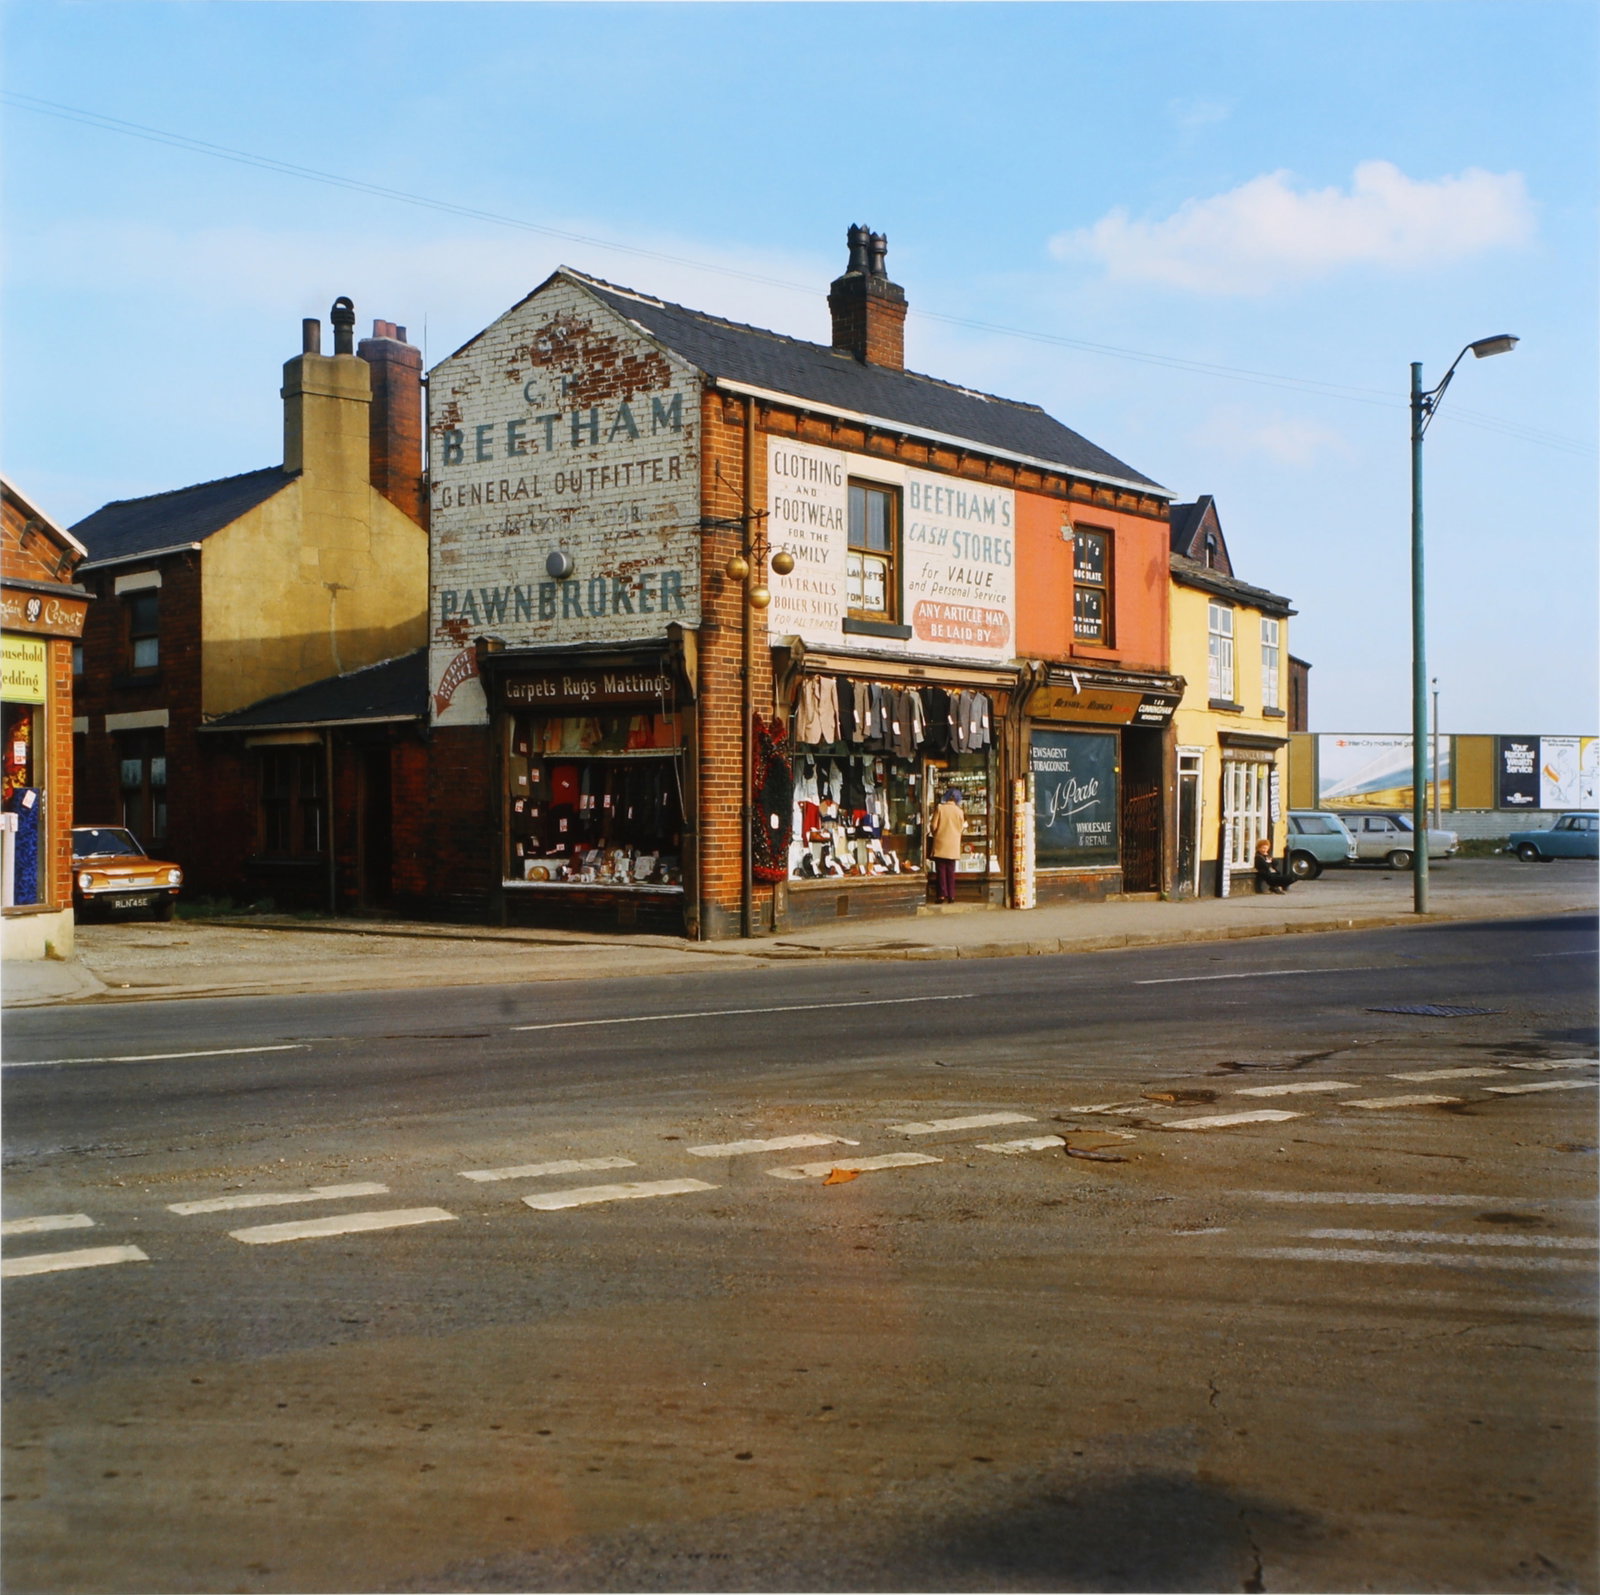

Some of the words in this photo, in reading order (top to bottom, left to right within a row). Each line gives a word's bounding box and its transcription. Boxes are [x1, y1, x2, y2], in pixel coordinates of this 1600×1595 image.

[442, 392, 682, 467] BEETHAM
[774, 451, 842, 487] CLOTHING
[442, 473, 543, 508] GENERAL
[554, 455, 681, 496] OUTFITTER
[796, 485, 817, 497] AND
[774, 496, 843, 531] FOOTWEAR
[910, 481, 1011, 527] BEETHAM'S
[788, 528, 805, 538] FOR
[811, 533, 829, 543] THE
[909, 522, 948, 546] CASH
[952, 530, 1012, 567] STORES
[783, 543, 830, 564] FAMILY
[780, 576, 837, 596] OVERALLS
[921, 562, 939, 580] for
[948, 566, 993, 588] VALUE
[1073, 569, 1102, 582] HOCOLATE
[441, 570, 686, 626] PAWNBROKER
[909, 579, 926, 592] and
[974, 588, 1007, 604] Service
[27, 599, 40, 616] 98
[774, 595, 807, 614] BOILER
[811, 598, 839, 617] SUITS
[918, 603, 941, 618] ANY
[944, 606, 983, 626] ARTICLE
[930, 623, 945, 638] BE
[947, 625, 971, 640] LAID
[977, 627, 992, 642] BY
[2, 644, 43, 662] ousehold
[2, 670, 39, 693] edding
[506, 679, 556, 702] Carpets
[563, 676, 597, 700] Rugs
[1030, 747, 1067, 759] EWSAGENT
[1076, 822, 1112, 833] WHOLESALE
